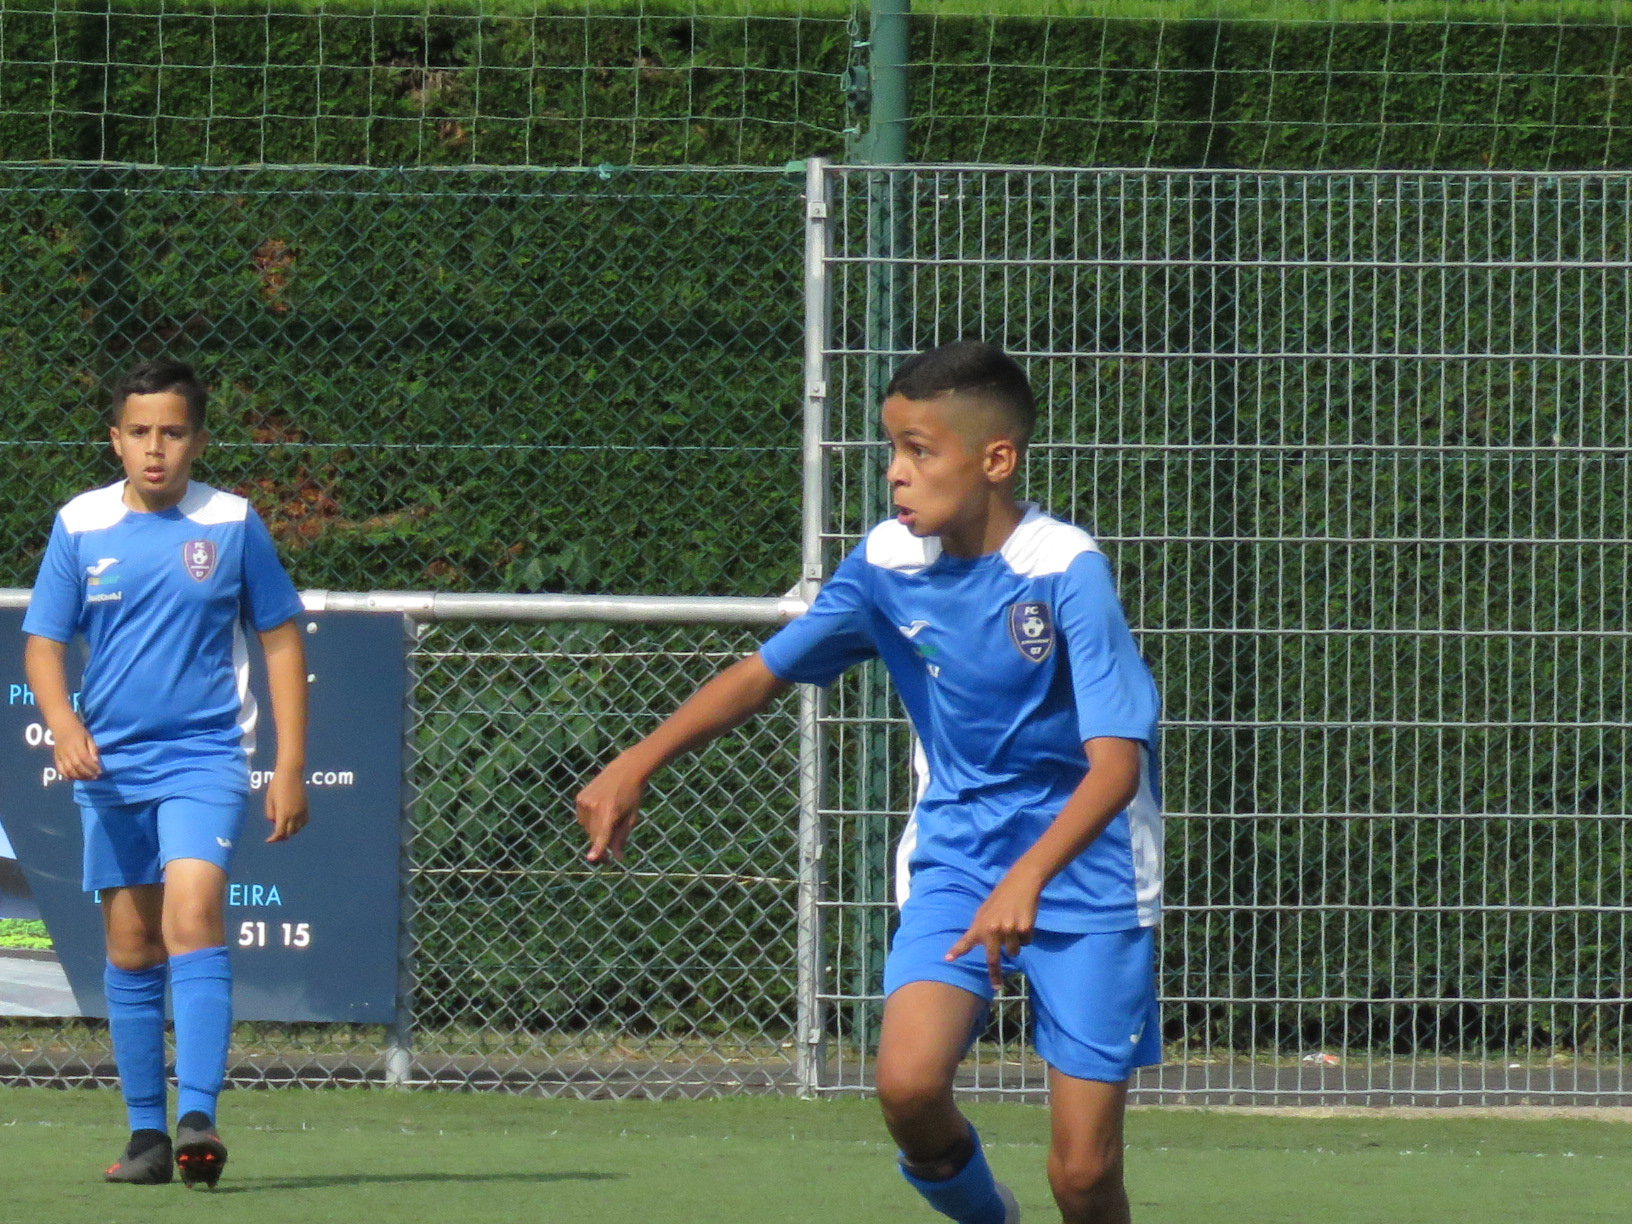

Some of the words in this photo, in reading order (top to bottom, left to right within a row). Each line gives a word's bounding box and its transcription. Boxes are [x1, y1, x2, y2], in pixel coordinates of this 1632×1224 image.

[1024, 606, 1039, 616] FC
[238, 921, 266, 947] 51
[282, 922, 310, 947] 15
